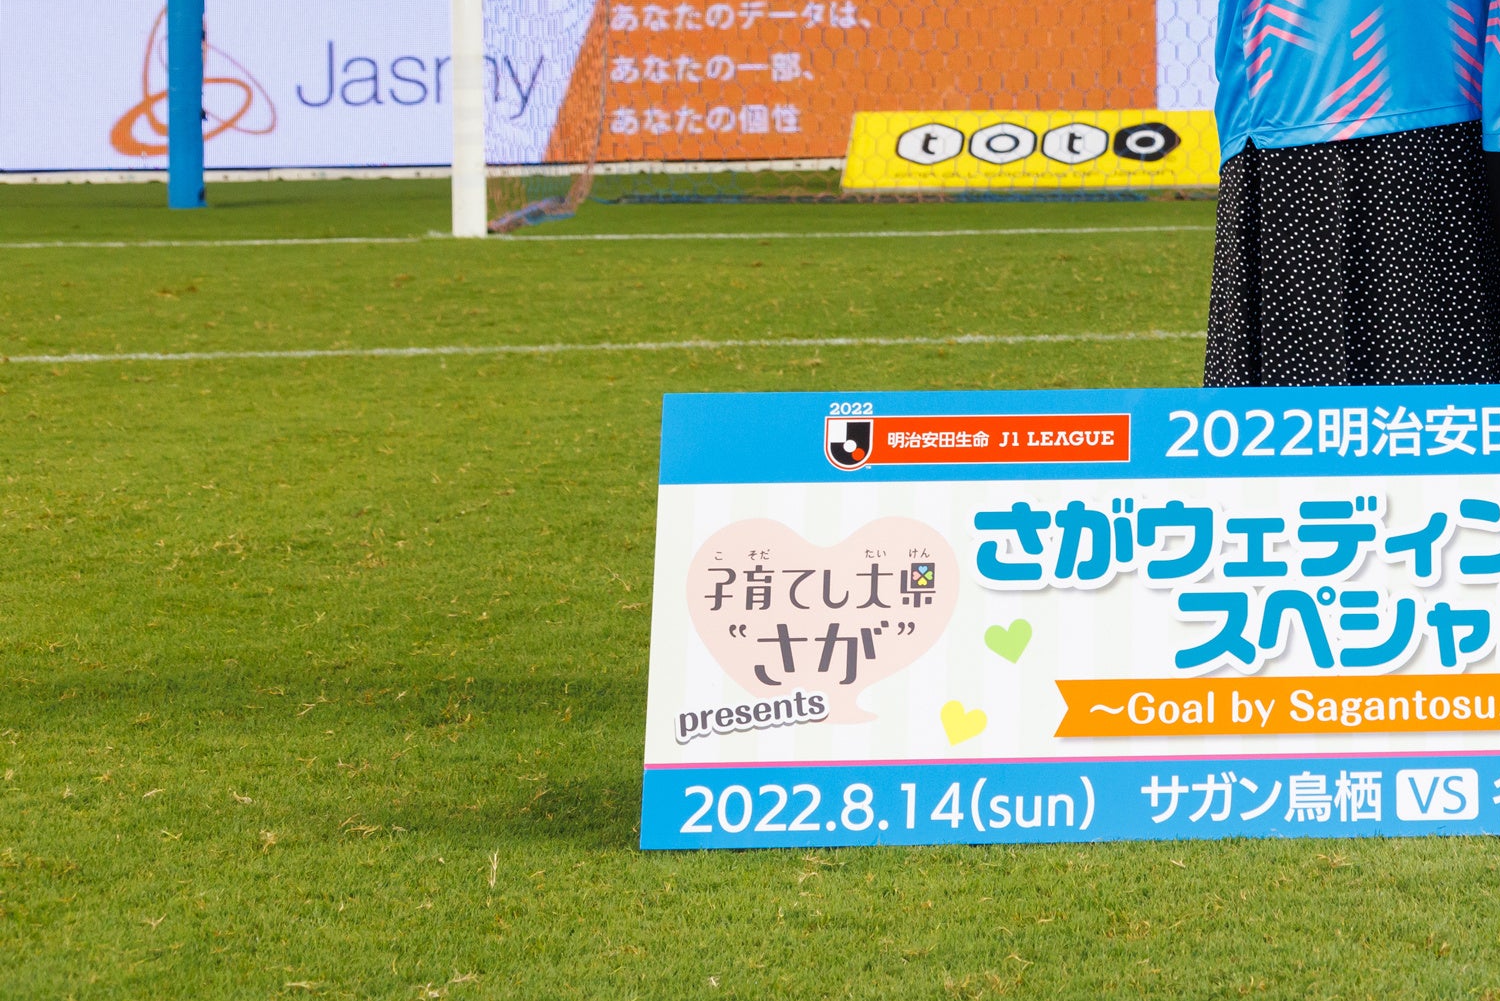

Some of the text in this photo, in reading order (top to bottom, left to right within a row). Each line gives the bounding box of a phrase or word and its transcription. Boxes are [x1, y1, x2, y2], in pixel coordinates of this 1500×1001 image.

[610, 0, 872, 32] あなたのデータは、
[610, 52, 814, 84] あなたの一部、
[610, 104, 801, 135] あなたの個性
[908, 127, 1174, 160] toto
[829, 402, 874, 416] 2022
[887, 430, 1115, 449] 明治安田生命 J1 LEAGUE
[747, 549, 770, 561] そだ
[865, 549, 887, 559] たい
[908, 547, 931, 559] けん
[704, 562, 936, 611] 子育てし大県
[678, 691, 828, 738] presents
[1230, 690, 1276, 730] by
[680, 775, 1096, 835] 2022.8.14(sun)
[1141, 769, 1383, 825] サガン鳥栖
[1404, 777, 1470, 812] VS
